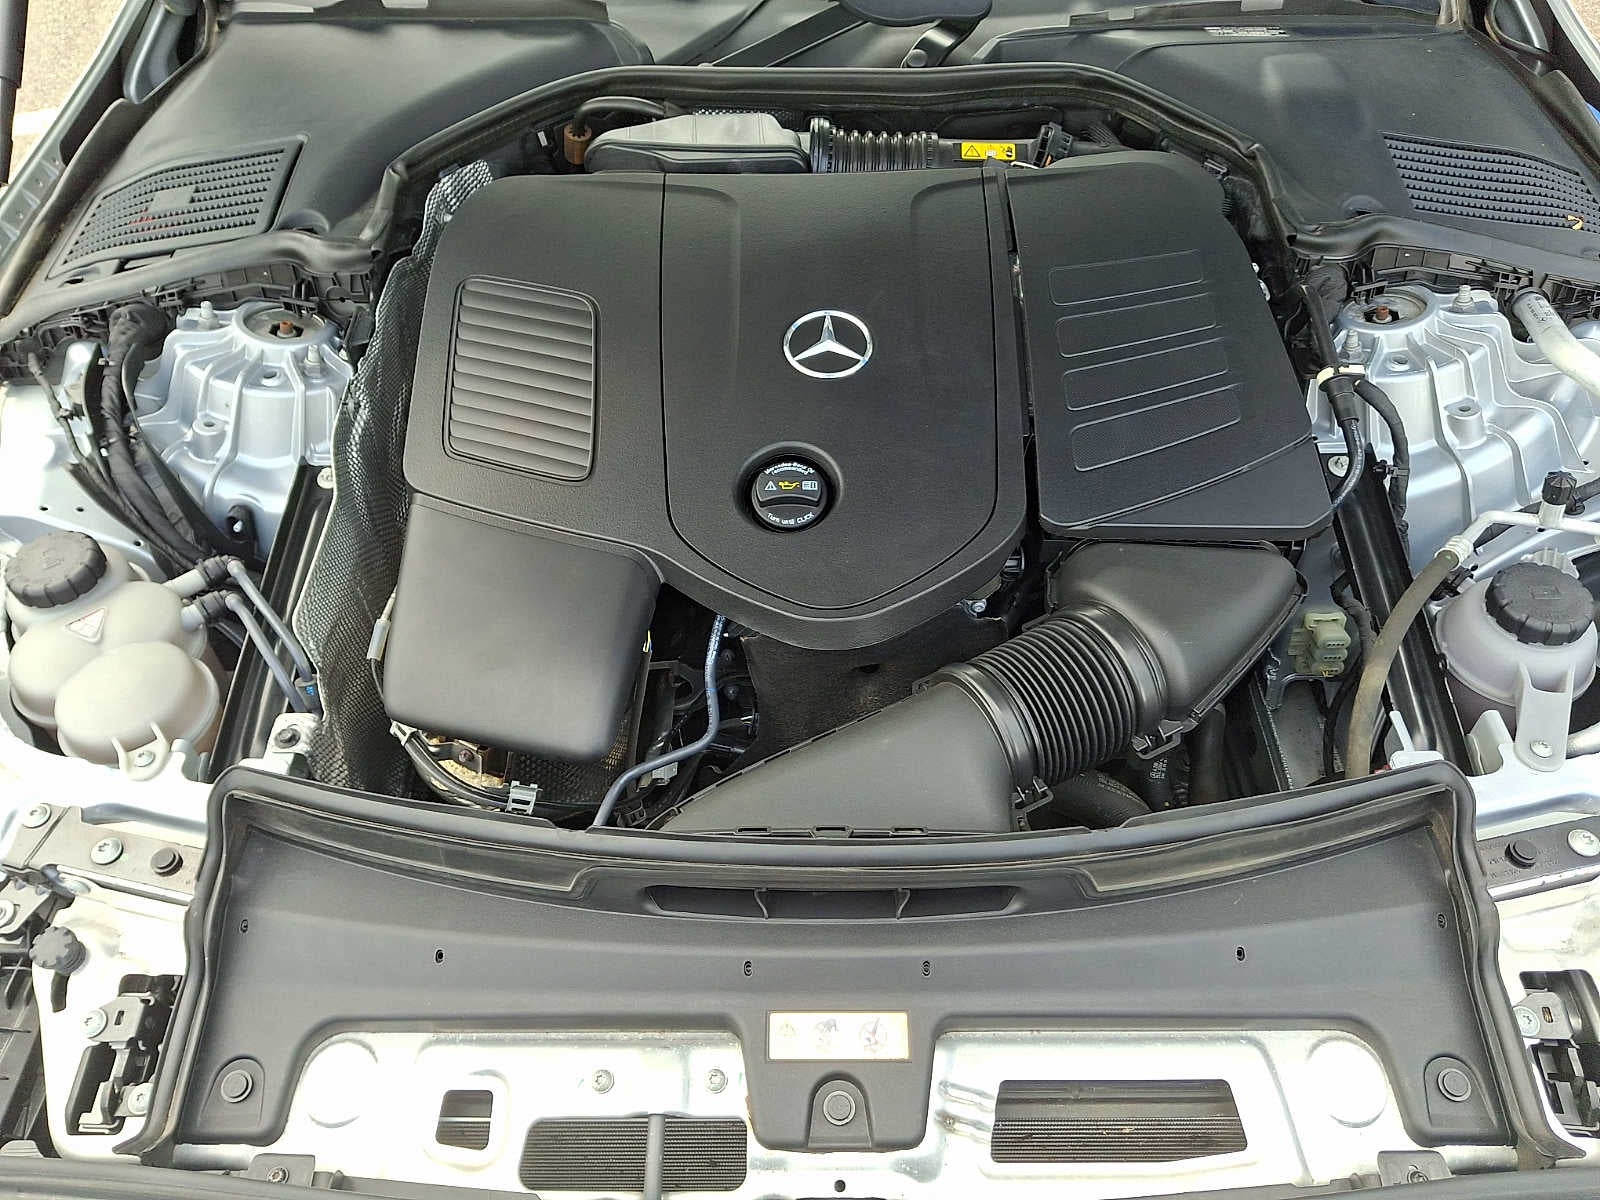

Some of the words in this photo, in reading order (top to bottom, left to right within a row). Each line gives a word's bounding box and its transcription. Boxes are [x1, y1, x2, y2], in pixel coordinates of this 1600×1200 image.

[764, 462, 807, 475] Mercedes-Benz
[767, 512, 780, 523] Turn
[796, 511, 815, 524] CLICK
